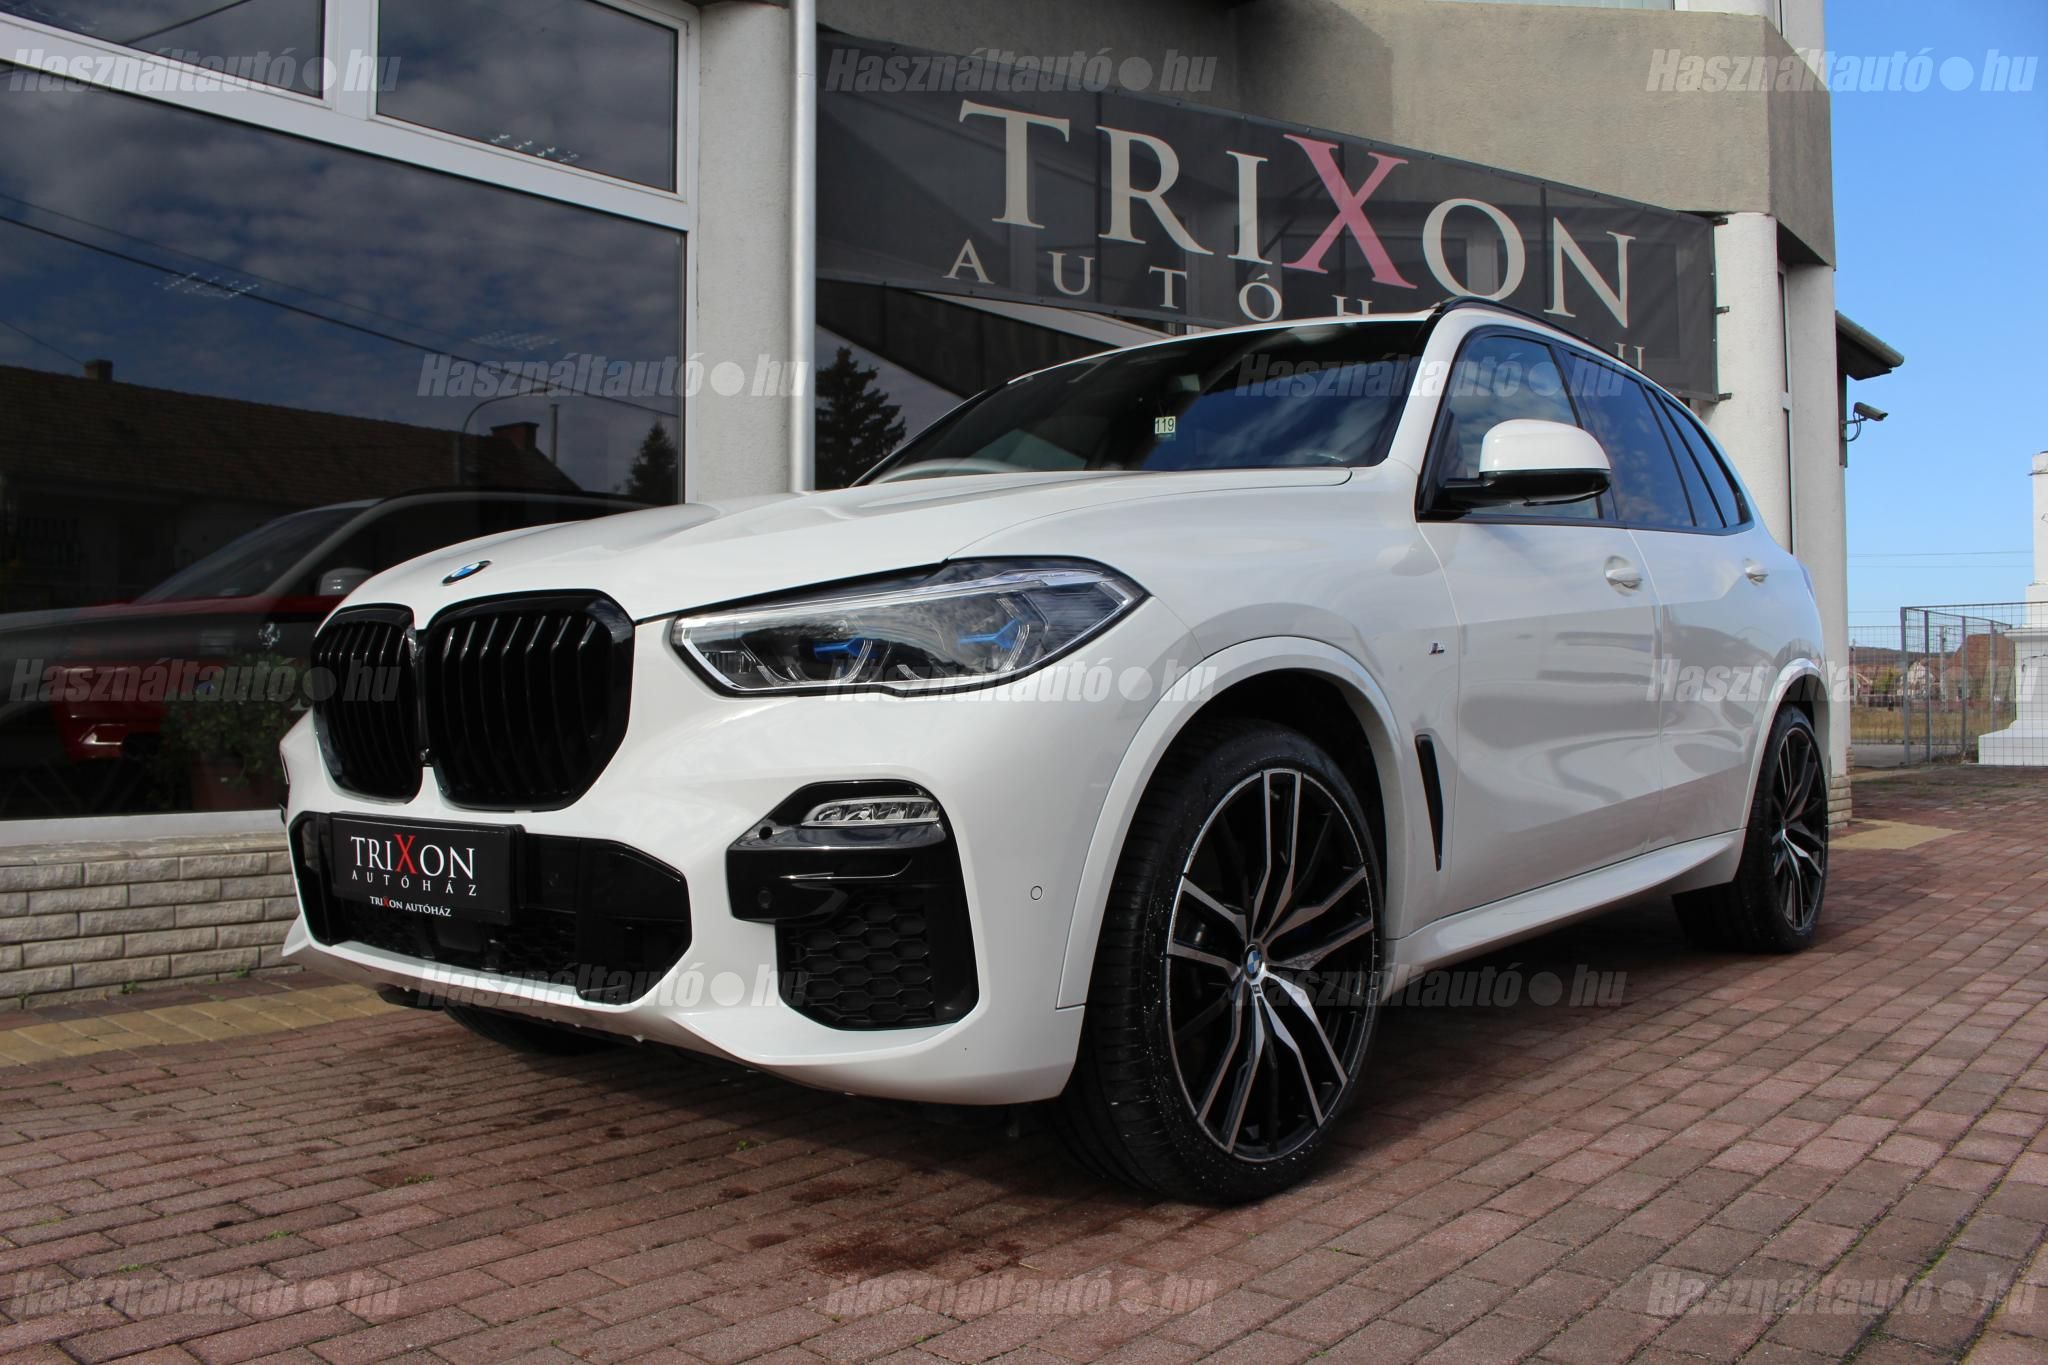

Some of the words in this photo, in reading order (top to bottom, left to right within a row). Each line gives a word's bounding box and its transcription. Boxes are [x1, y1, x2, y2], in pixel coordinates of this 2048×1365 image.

[959, 99, 1636, 329] TRIXON
[350, 834, 475, 880] TRIXON
[351, 869, 477, 897] AUTÓHÁZ
[369, 896, 403, 909] TRIXON
[405, 902, 452, 917] AUTÓHÁZ
